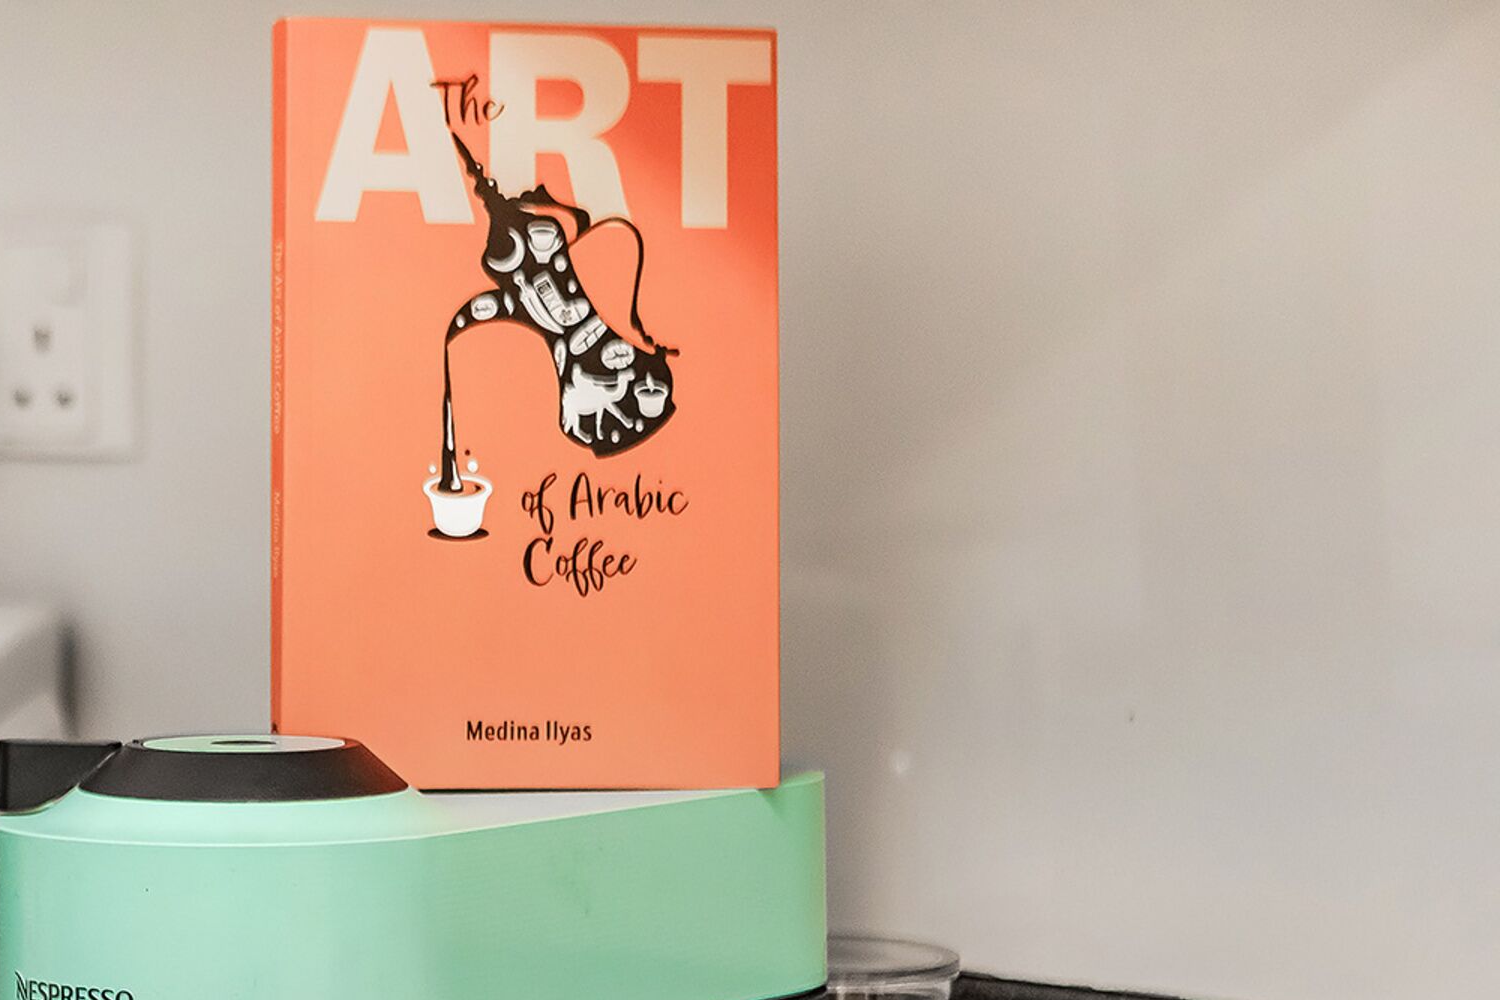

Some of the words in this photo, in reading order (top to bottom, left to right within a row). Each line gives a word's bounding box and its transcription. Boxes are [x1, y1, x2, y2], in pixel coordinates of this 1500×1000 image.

[314, 27, 771, 229] ART
[429, 74, 504, 126] The
[521, 473, 557, 534] of
[569, 472, 689, 519] Arabic
[522, 537, 637, 597] Coffee
[467, 720, 540, 741] Medina
[546, 720, 592, 746] Ilyas
